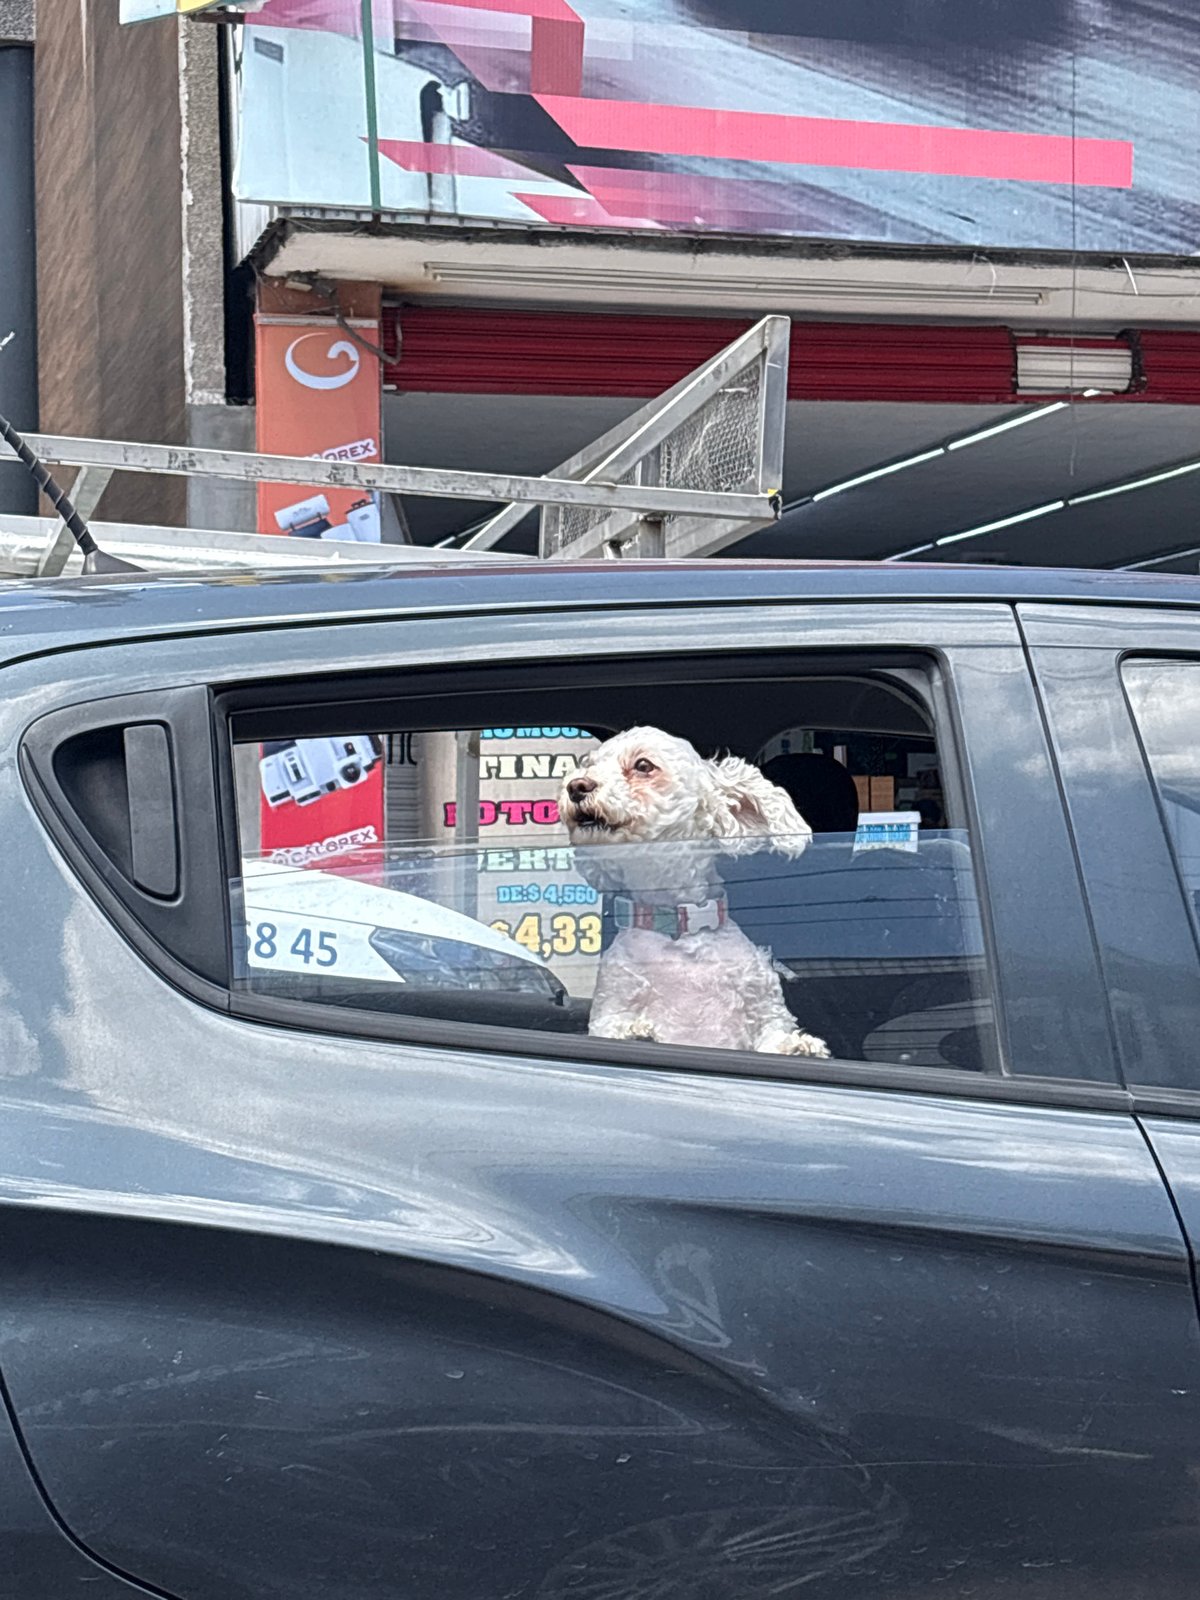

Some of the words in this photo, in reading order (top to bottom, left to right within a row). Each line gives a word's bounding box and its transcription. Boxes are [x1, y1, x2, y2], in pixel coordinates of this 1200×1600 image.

[323, 441, 373, 461] OREX
[479, 754, 590, 779] TINA
[477, 848, 576, 873] ERT
[290, 928, 338, 967] 45
